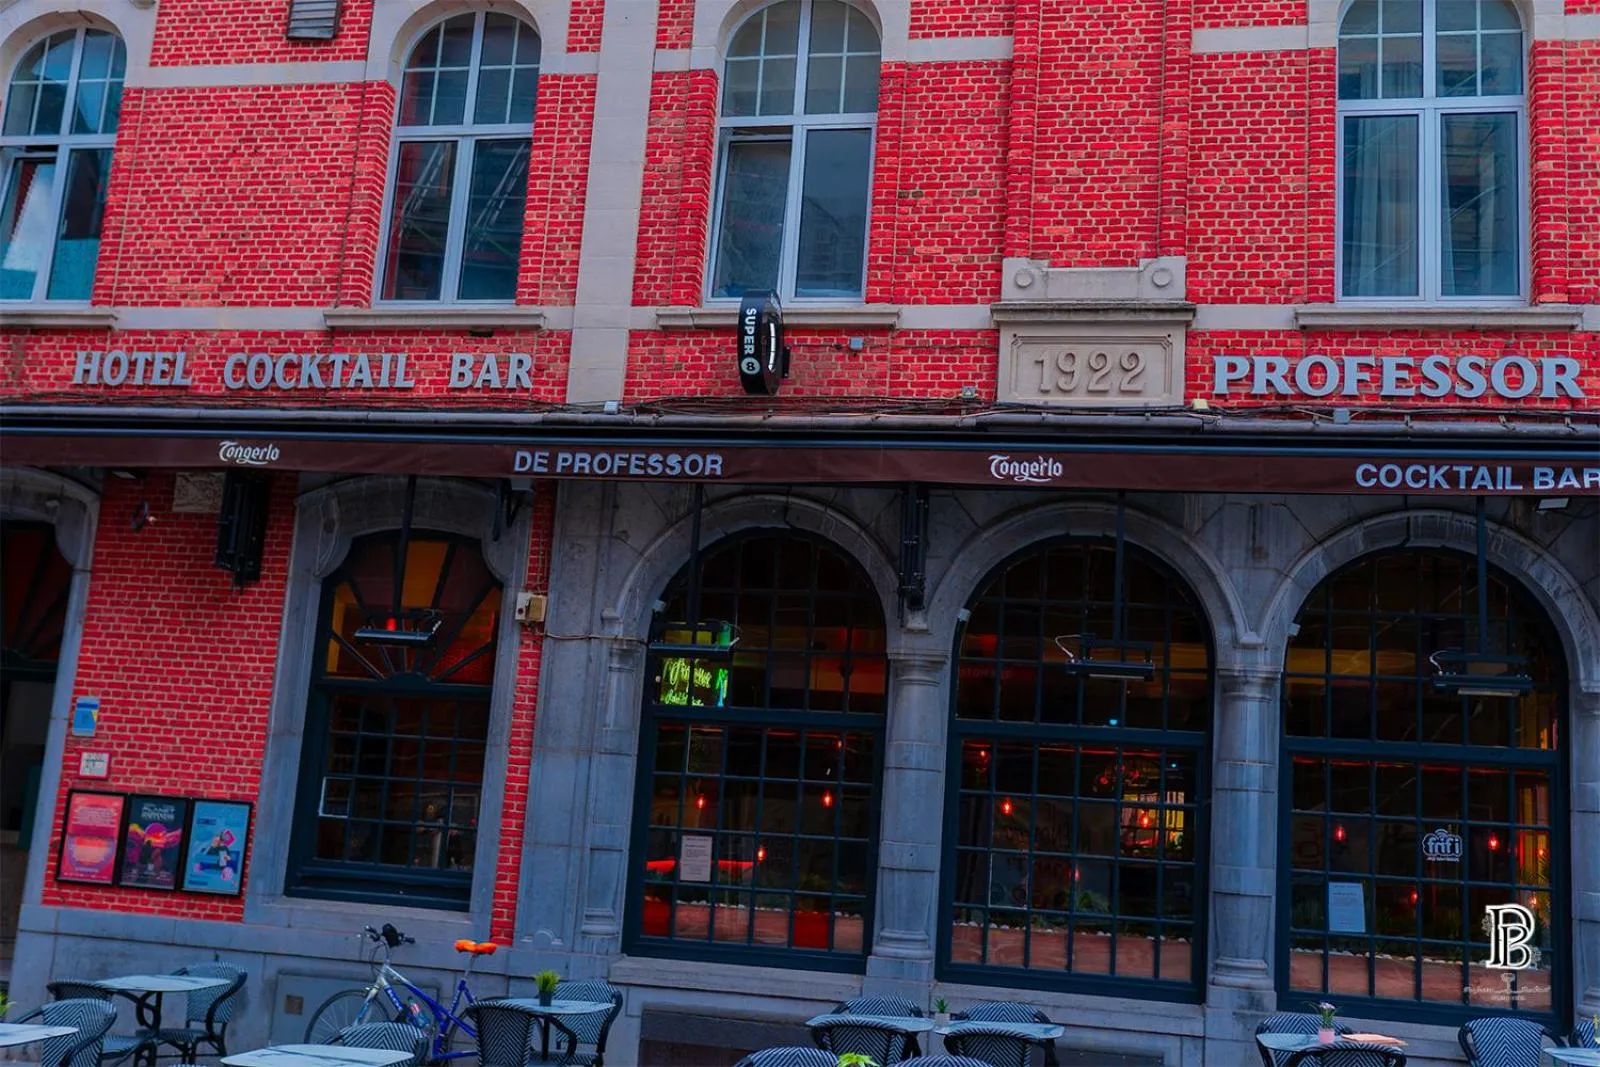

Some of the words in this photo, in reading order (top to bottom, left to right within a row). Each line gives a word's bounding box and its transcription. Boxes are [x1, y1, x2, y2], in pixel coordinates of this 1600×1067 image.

[744, 308, 757, 354] SUPER
[72, 349, 192, 386] HOTEL
[224, 353, 414, 390] COCKTAIL
[449, 353, 533, 389] BAR
[1034, 350, 1147, 393] 1922
[1212, 354, 1585, 398] PROFESSOR
[219, 441, 280, 465] Tongerlo
[514, 451, 549, 473] DE
[556, 453, 723, 476] PROFESSOR
[988, 454, 1063, 482] Tongerlo
[1355, 463, 1523, 490] COCKTAIL
[1427, 837, 1460, 854] frifi
